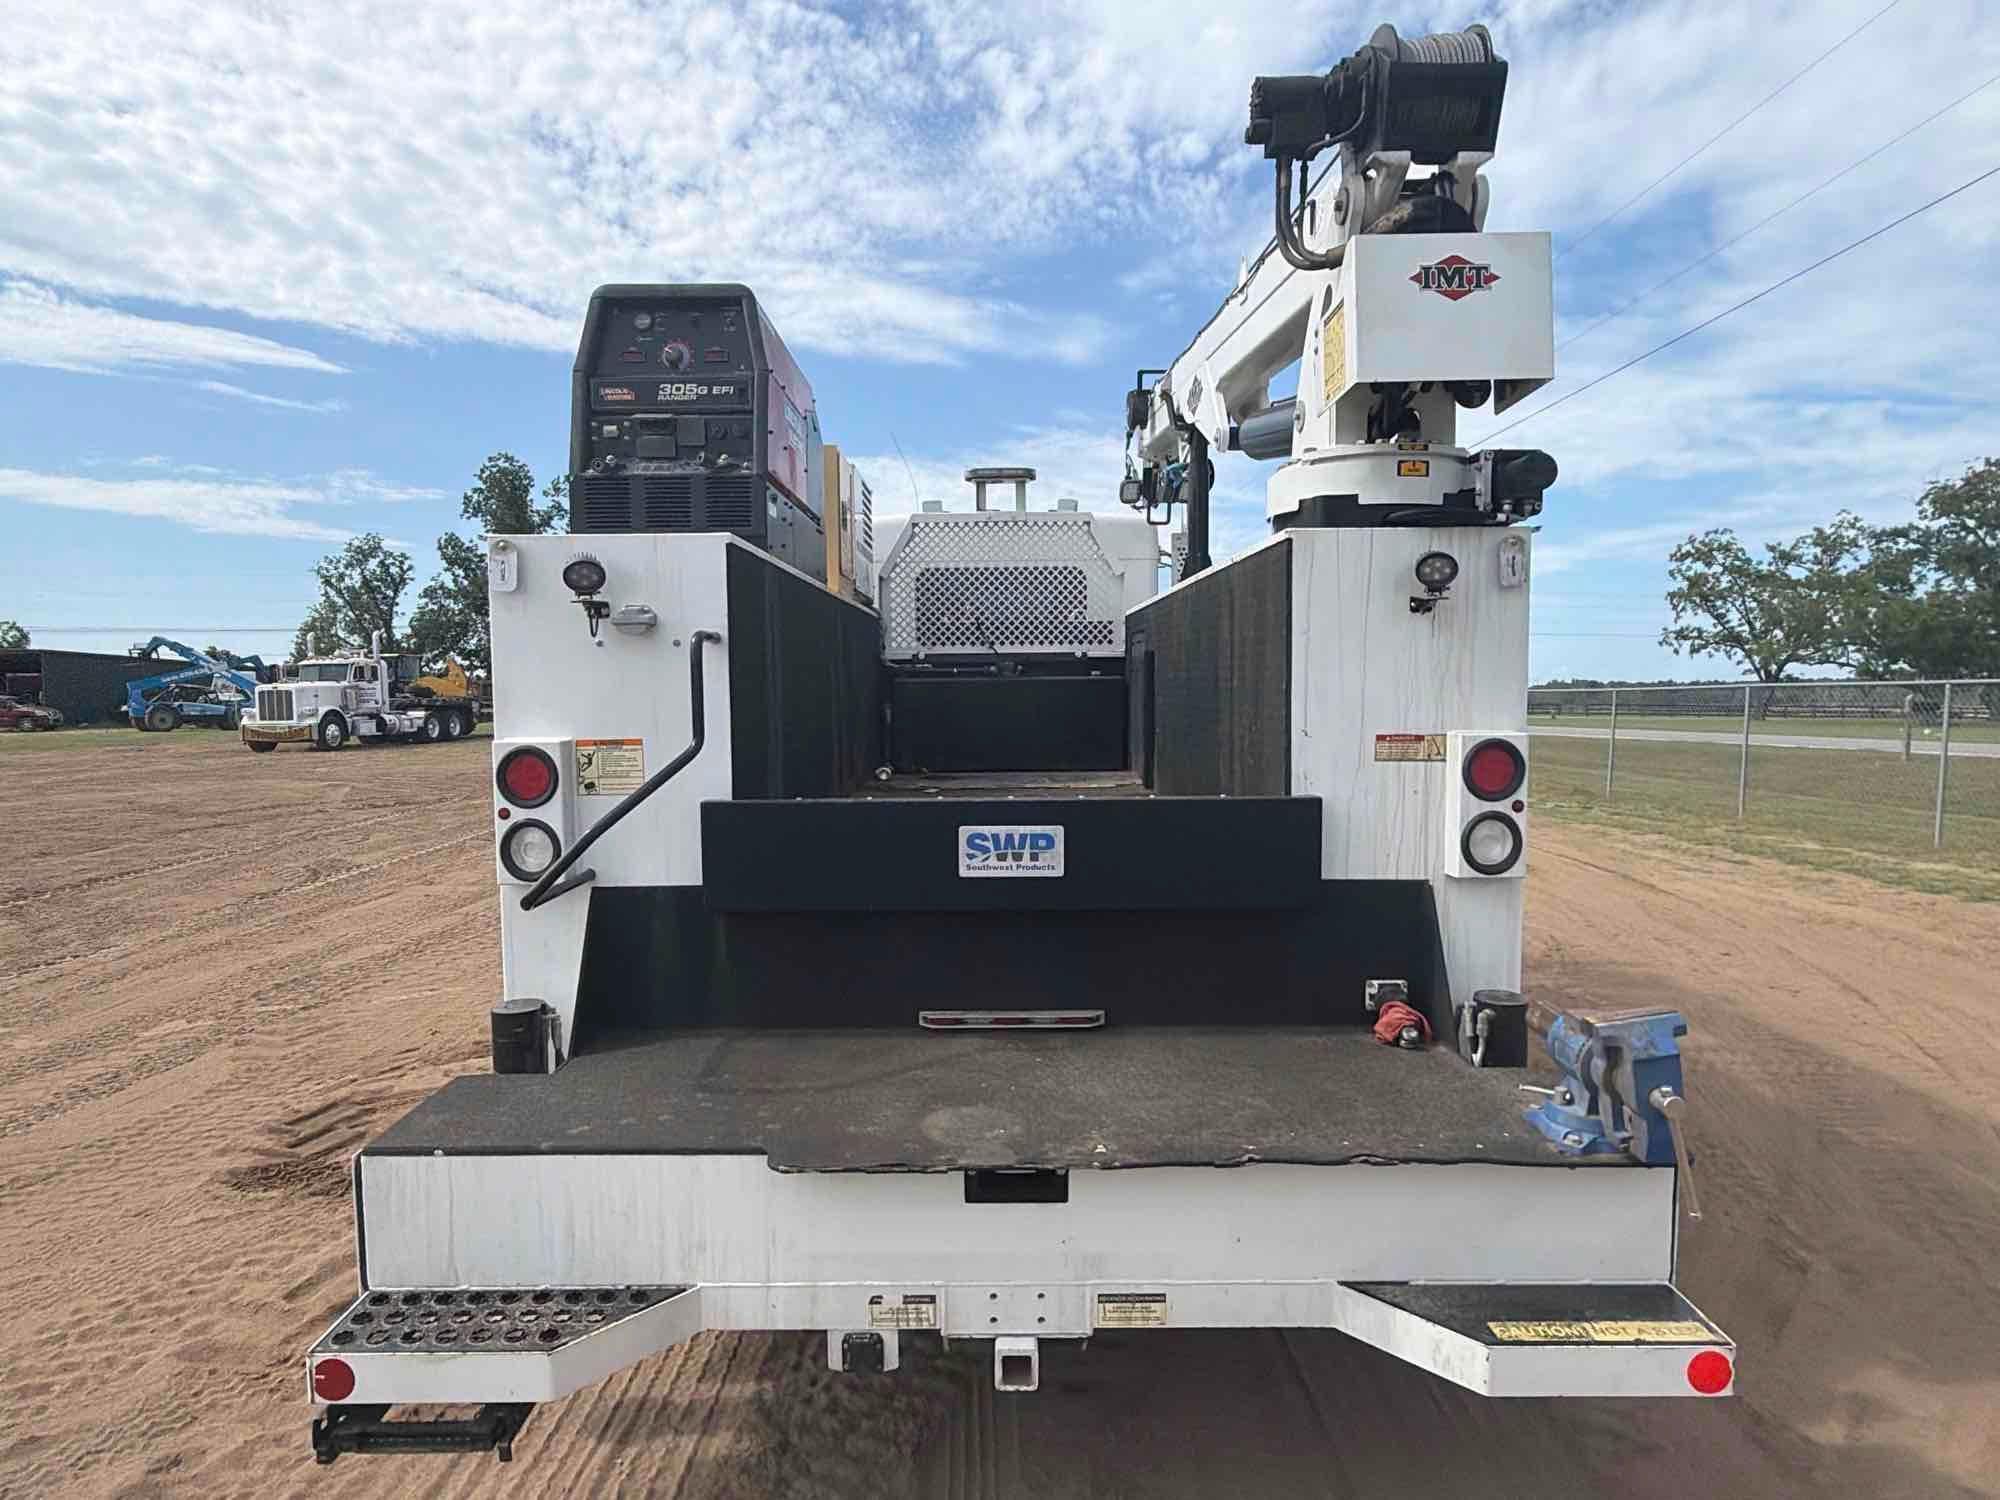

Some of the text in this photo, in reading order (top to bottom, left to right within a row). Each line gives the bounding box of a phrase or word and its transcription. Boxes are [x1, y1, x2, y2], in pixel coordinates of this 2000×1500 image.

[1419, 264, 1491, 290] IMT
[712, 386, 734, 394] EFI
[966, 832, 1056, 862] SWP
[966, 864, 1057, 872] Southwest Products
